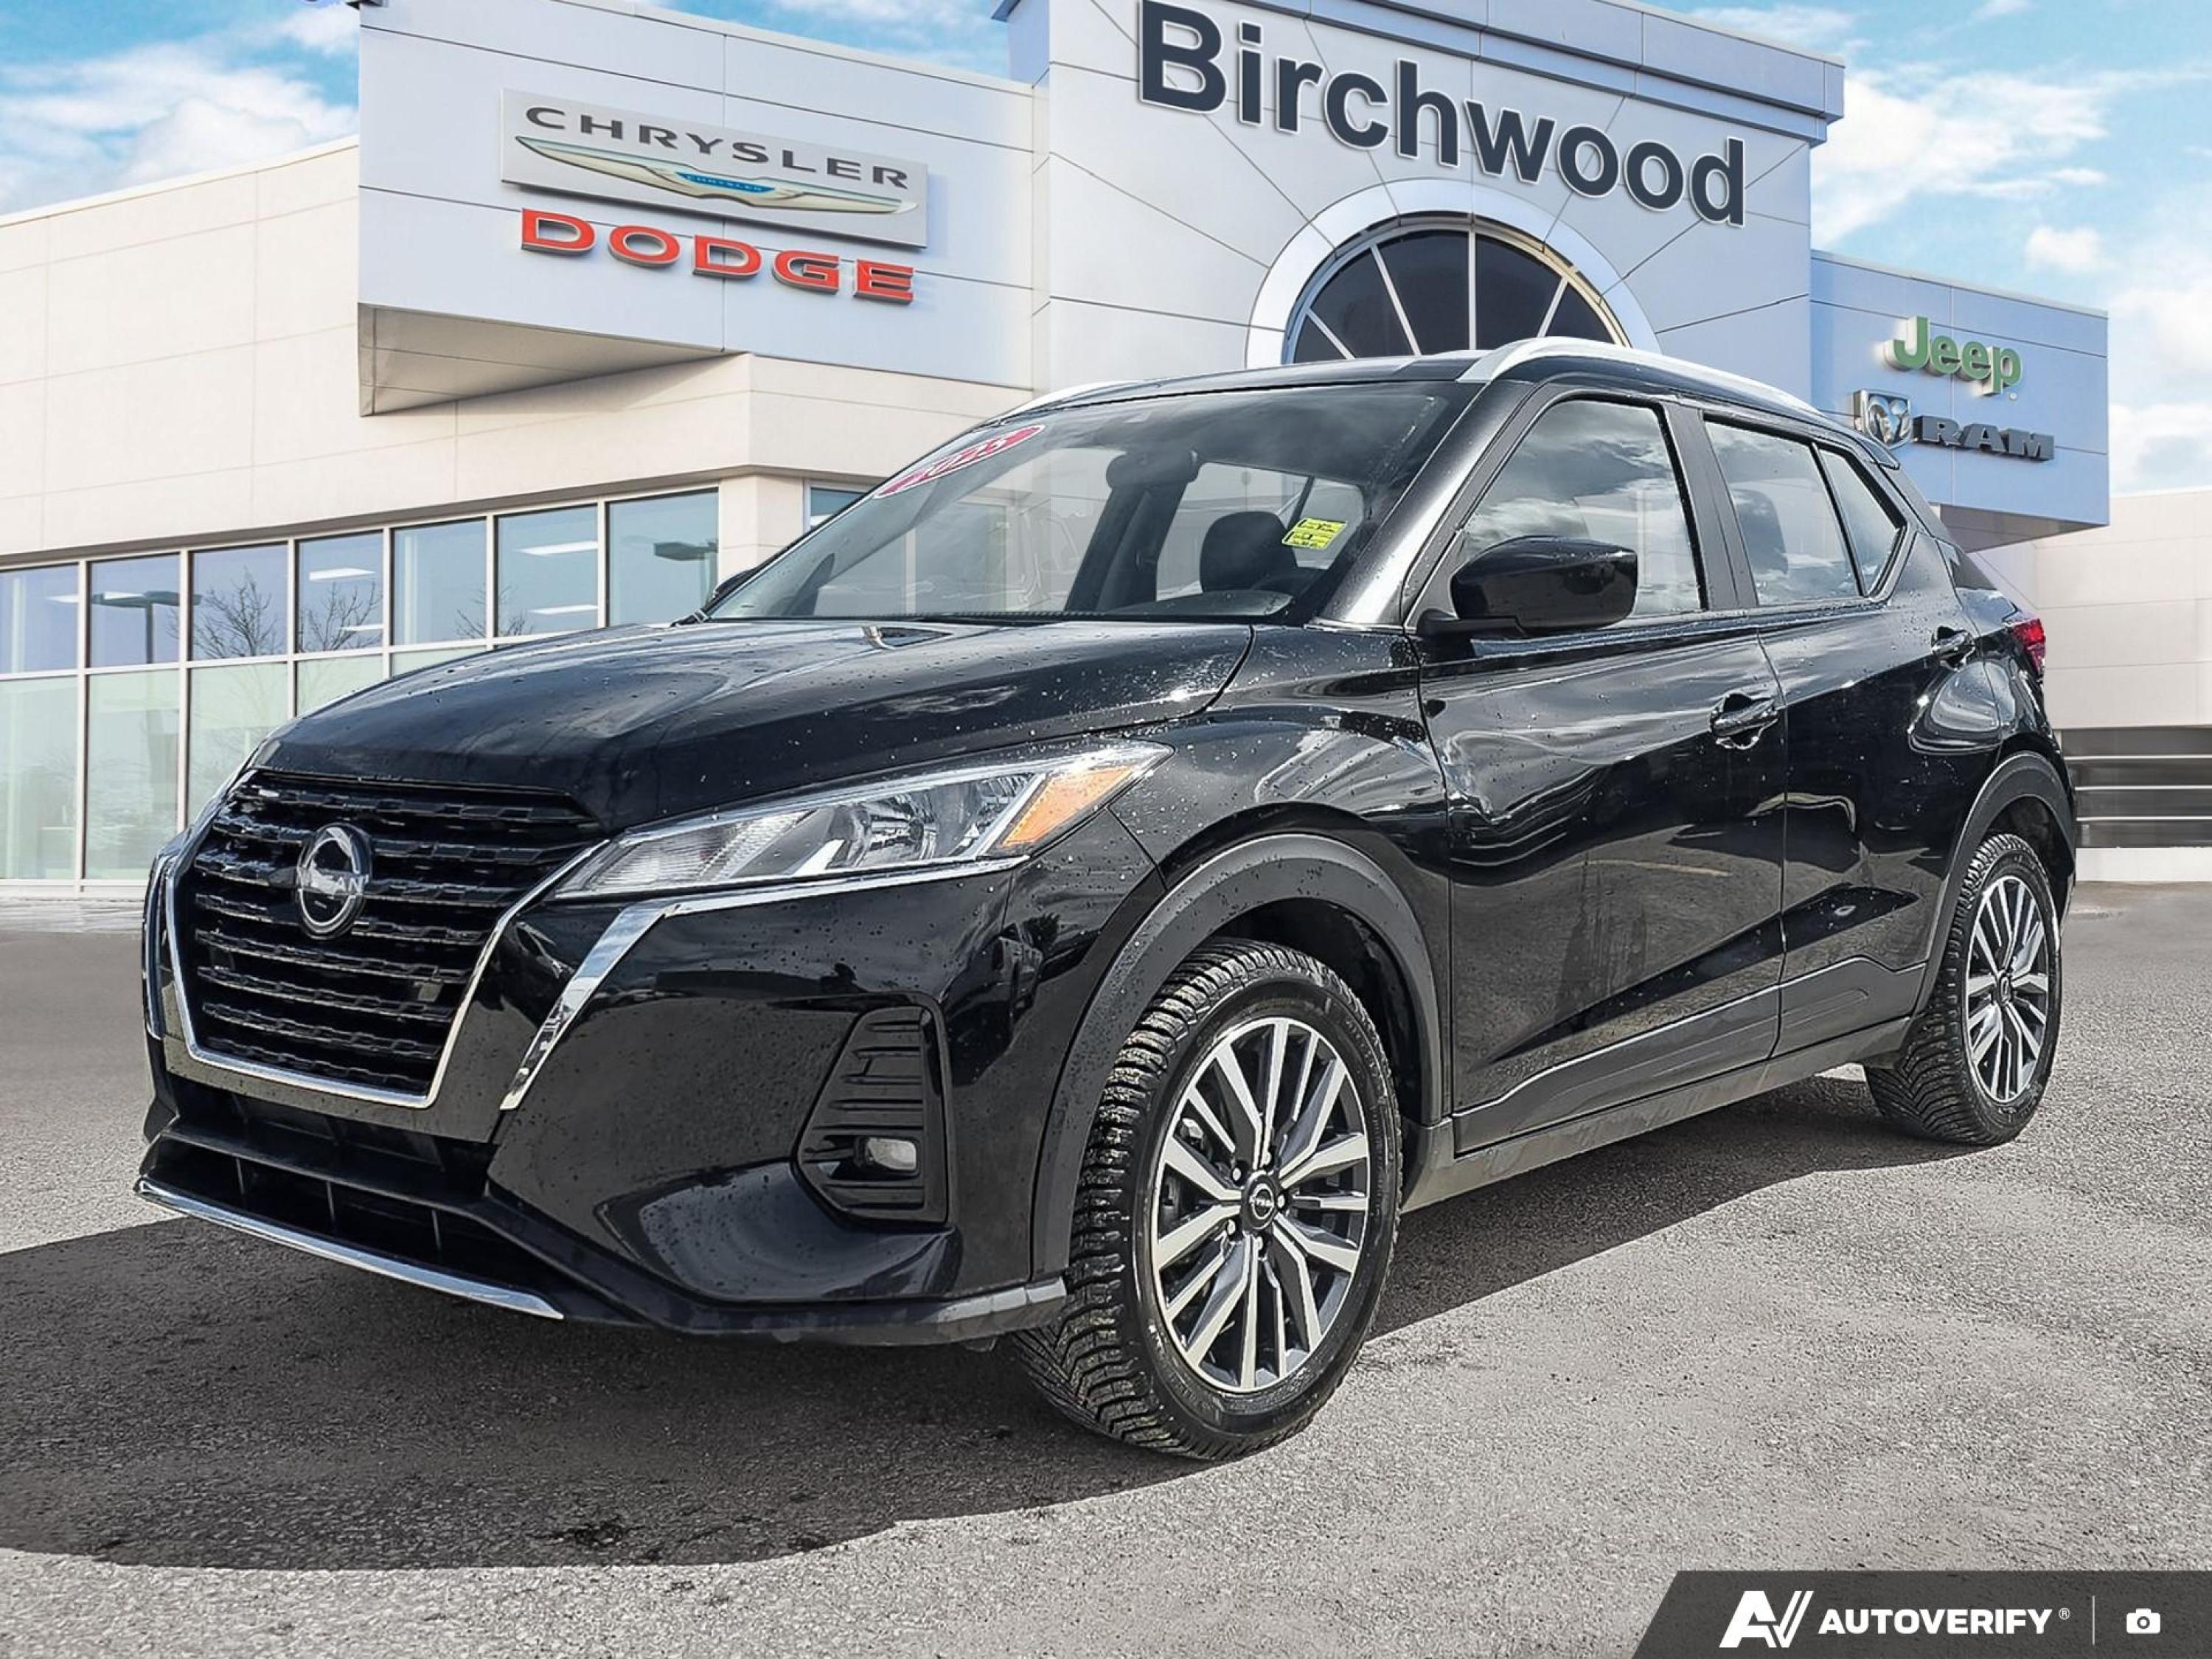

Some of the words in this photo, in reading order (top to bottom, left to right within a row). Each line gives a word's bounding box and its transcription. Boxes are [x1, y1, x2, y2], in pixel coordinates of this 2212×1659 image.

[525, 105, 908, 189] CHRYSLER
[1138, 0, 1745, 226] Birchwood
[521, 208, 914, 304] DODGE
[1885, 316, 2022, 394] Jeep
[1914, 415, 2056, 459] RAM
